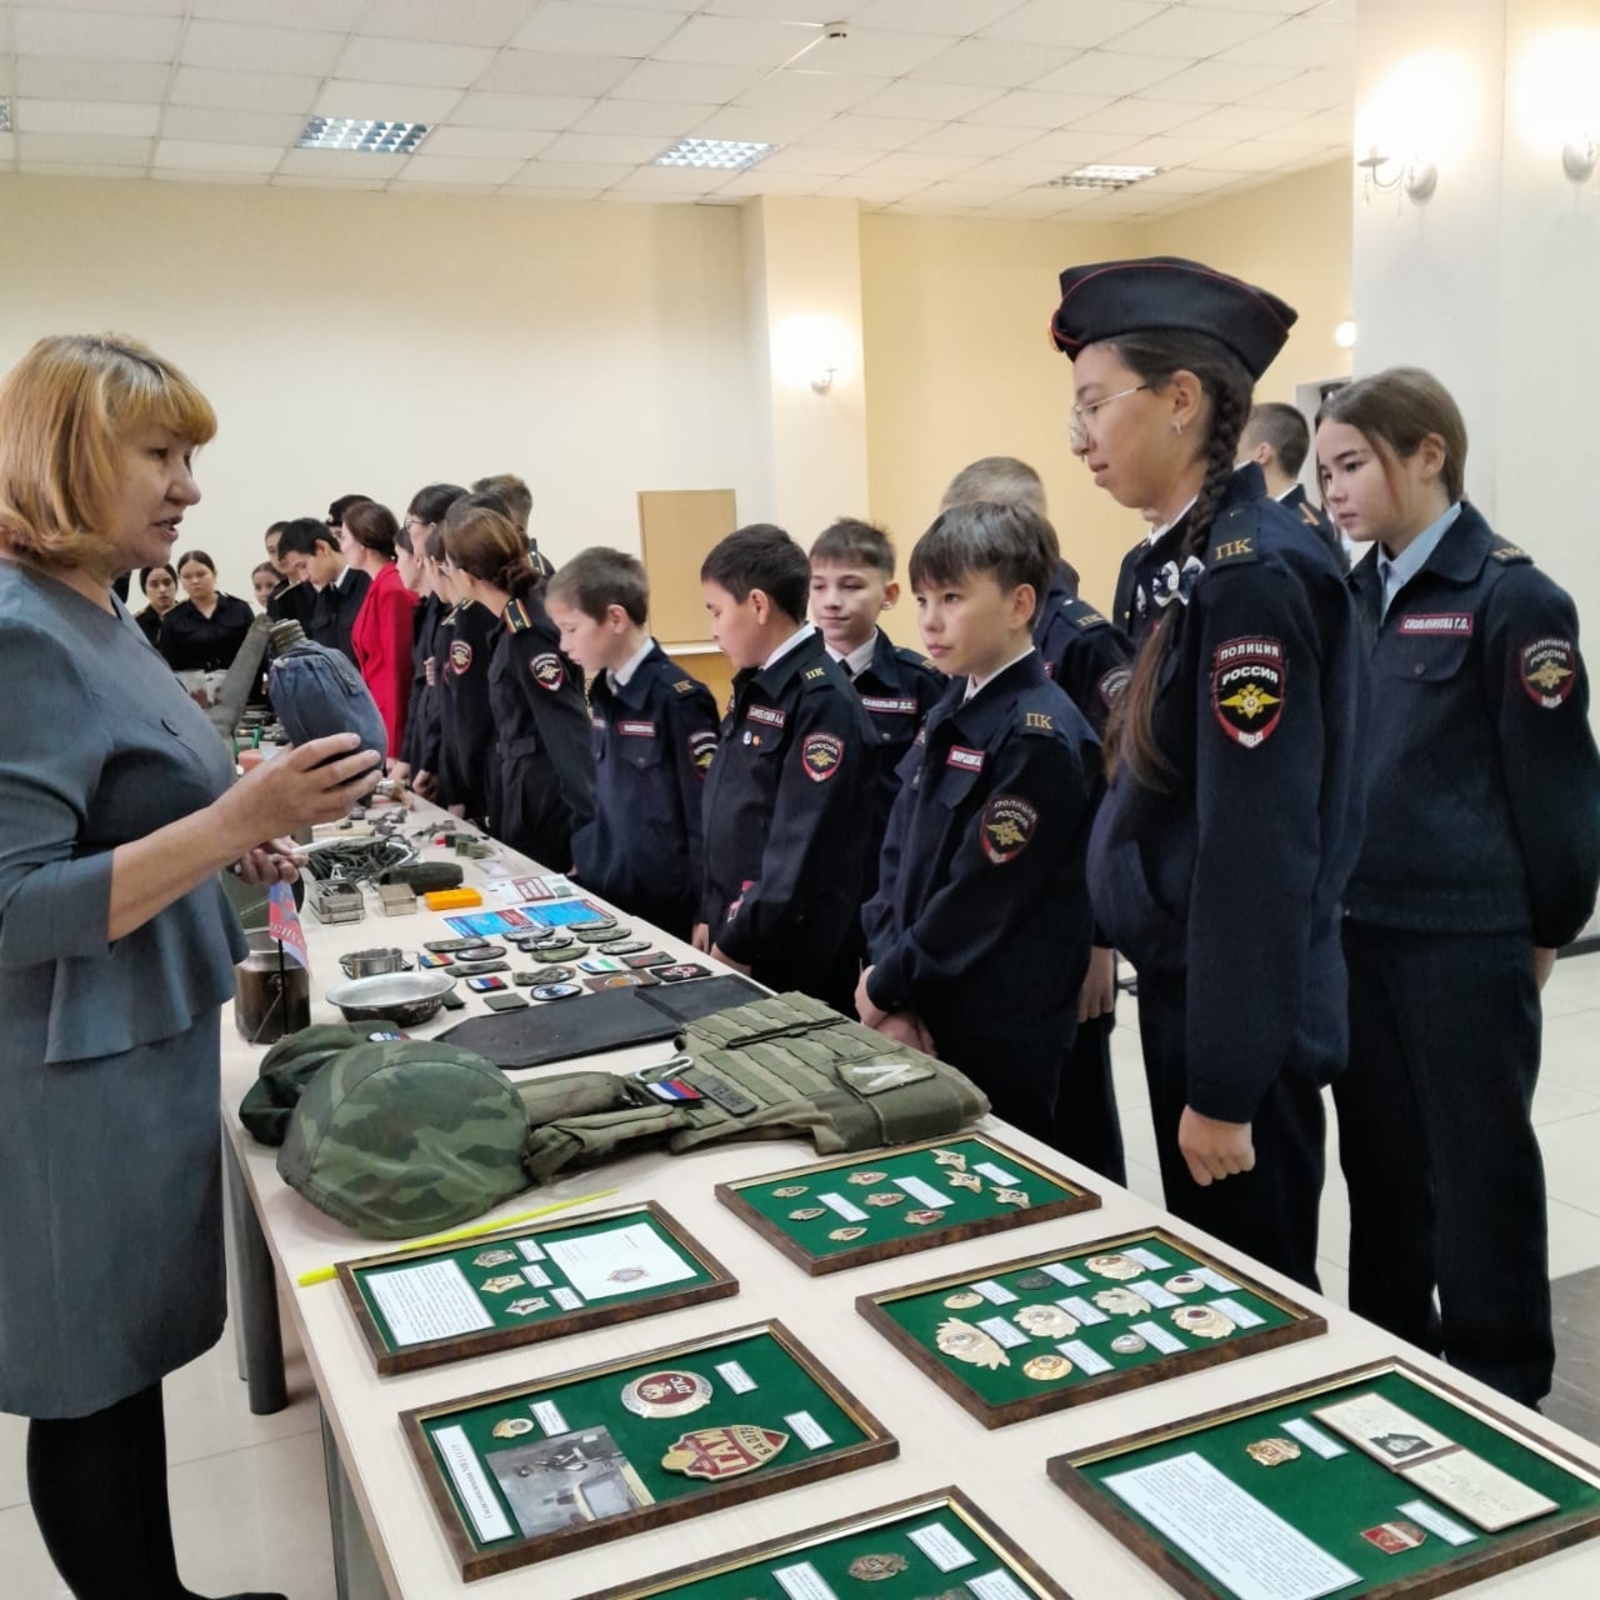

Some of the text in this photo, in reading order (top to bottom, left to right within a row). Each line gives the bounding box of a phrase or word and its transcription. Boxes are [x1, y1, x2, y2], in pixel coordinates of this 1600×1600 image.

[1213, 537, 1254, 561] ПК
[1221, 643, 1279, 661] ПОЛИЦИЯ
[1530, 649, 1567, 667] РОССИЯ
[1222, 666, 1278, 686] РОССИЯ
[1025, 712, 1053, 730] ПК
[670, 1376, 694, 1395] ДПС
[695, 1428, 748, 1474] ГАИ
